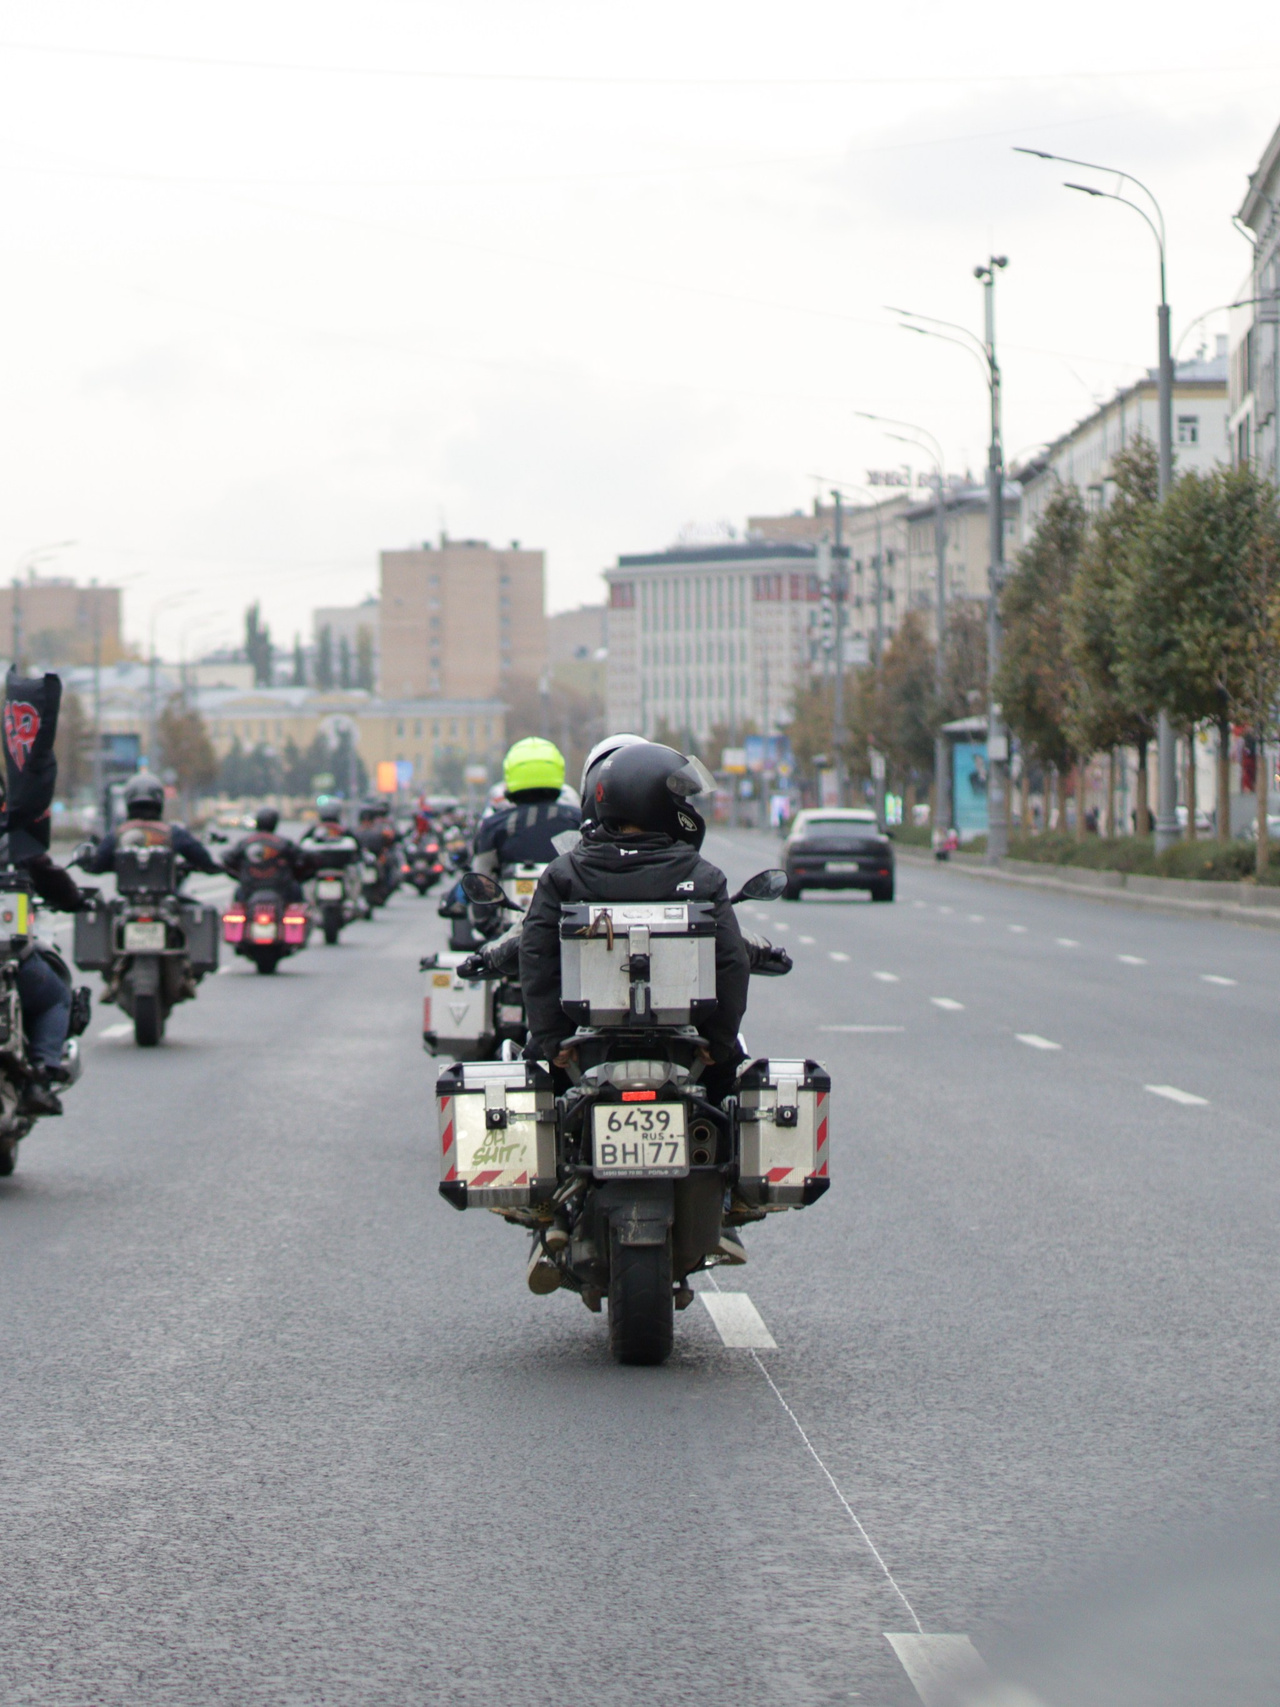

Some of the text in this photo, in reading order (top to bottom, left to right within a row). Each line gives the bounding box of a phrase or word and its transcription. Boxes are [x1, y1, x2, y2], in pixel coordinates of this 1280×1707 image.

[607, 1110, 671, 1132] 6439
[642, 1132, 665, 1140] RUS
[601, 1142, 679, 1165] BH 77
